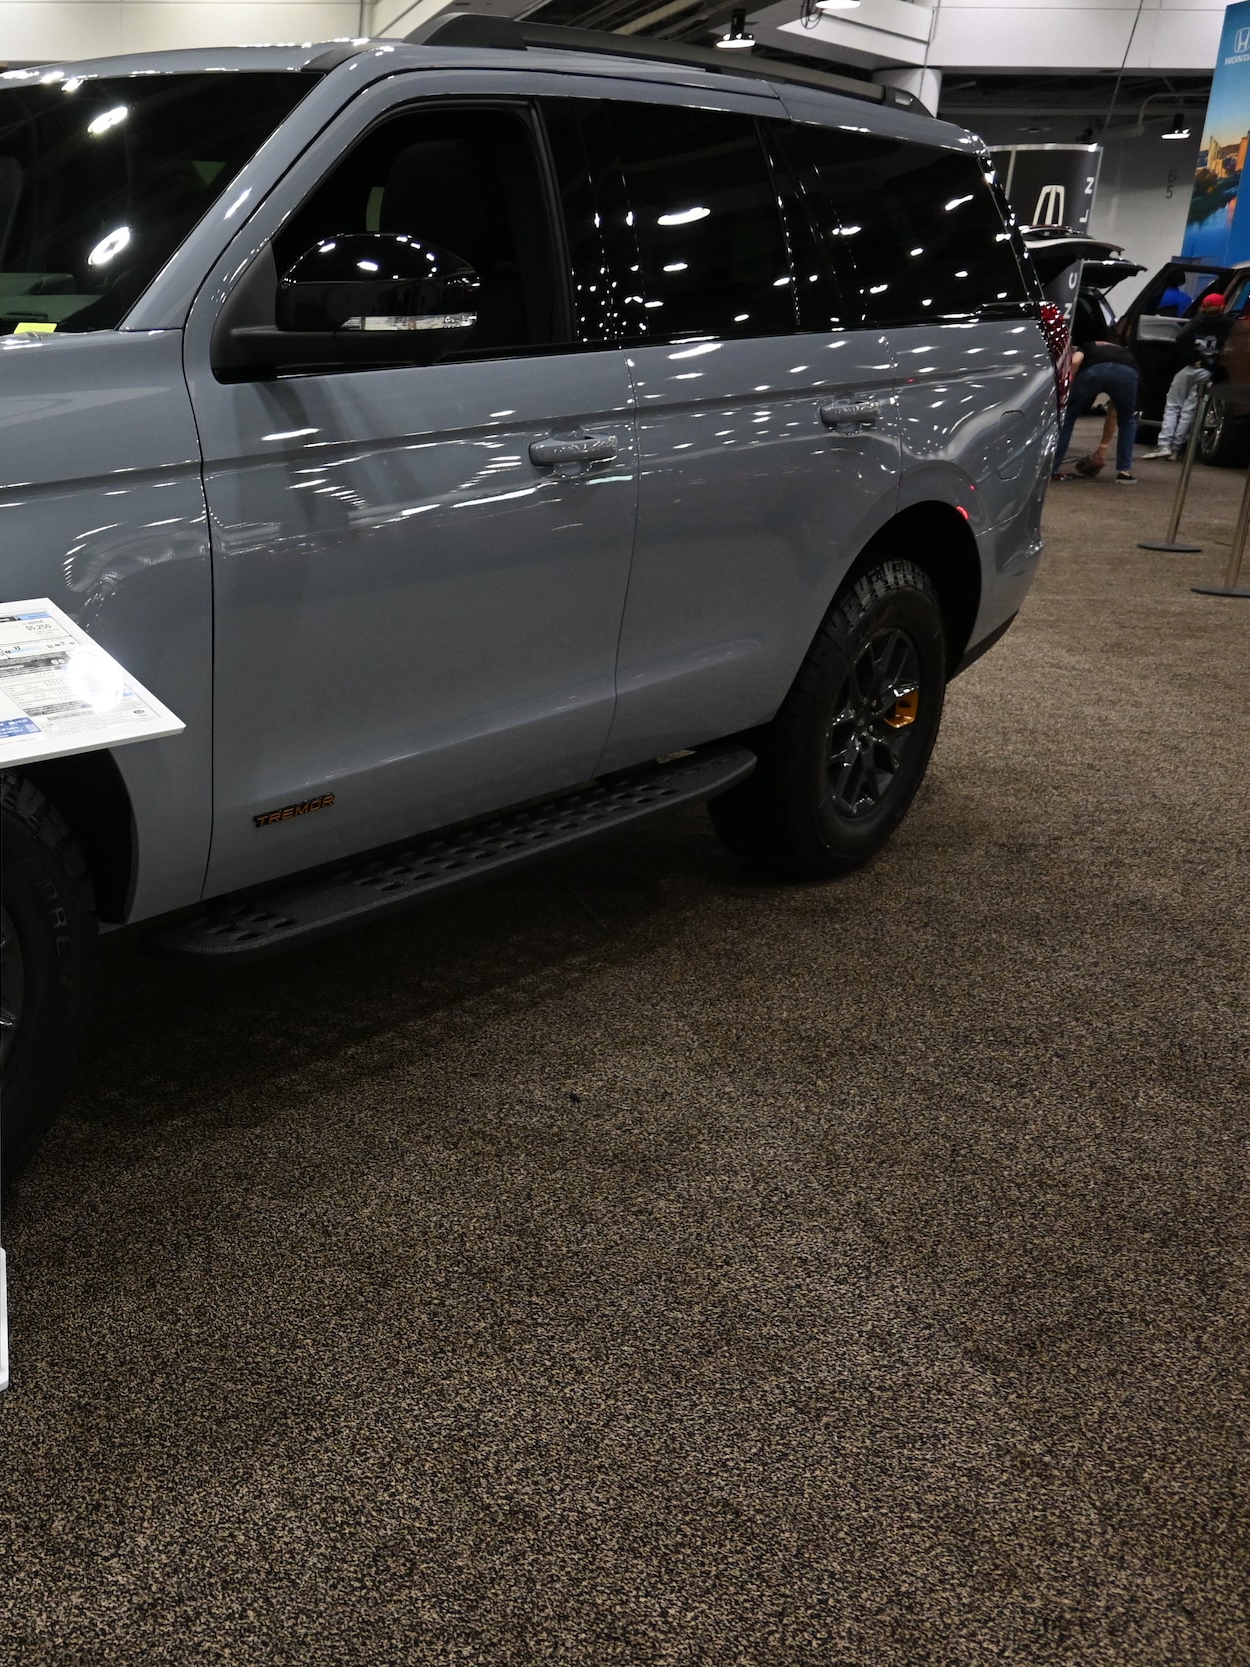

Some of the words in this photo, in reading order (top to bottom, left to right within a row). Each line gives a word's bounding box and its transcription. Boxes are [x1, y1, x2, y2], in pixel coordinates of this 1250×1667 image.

[1224, 54, 1250, 66] HOND
[1166, 169, 1177, 199] B5
[254, 793, 335, 827] TREMOR
